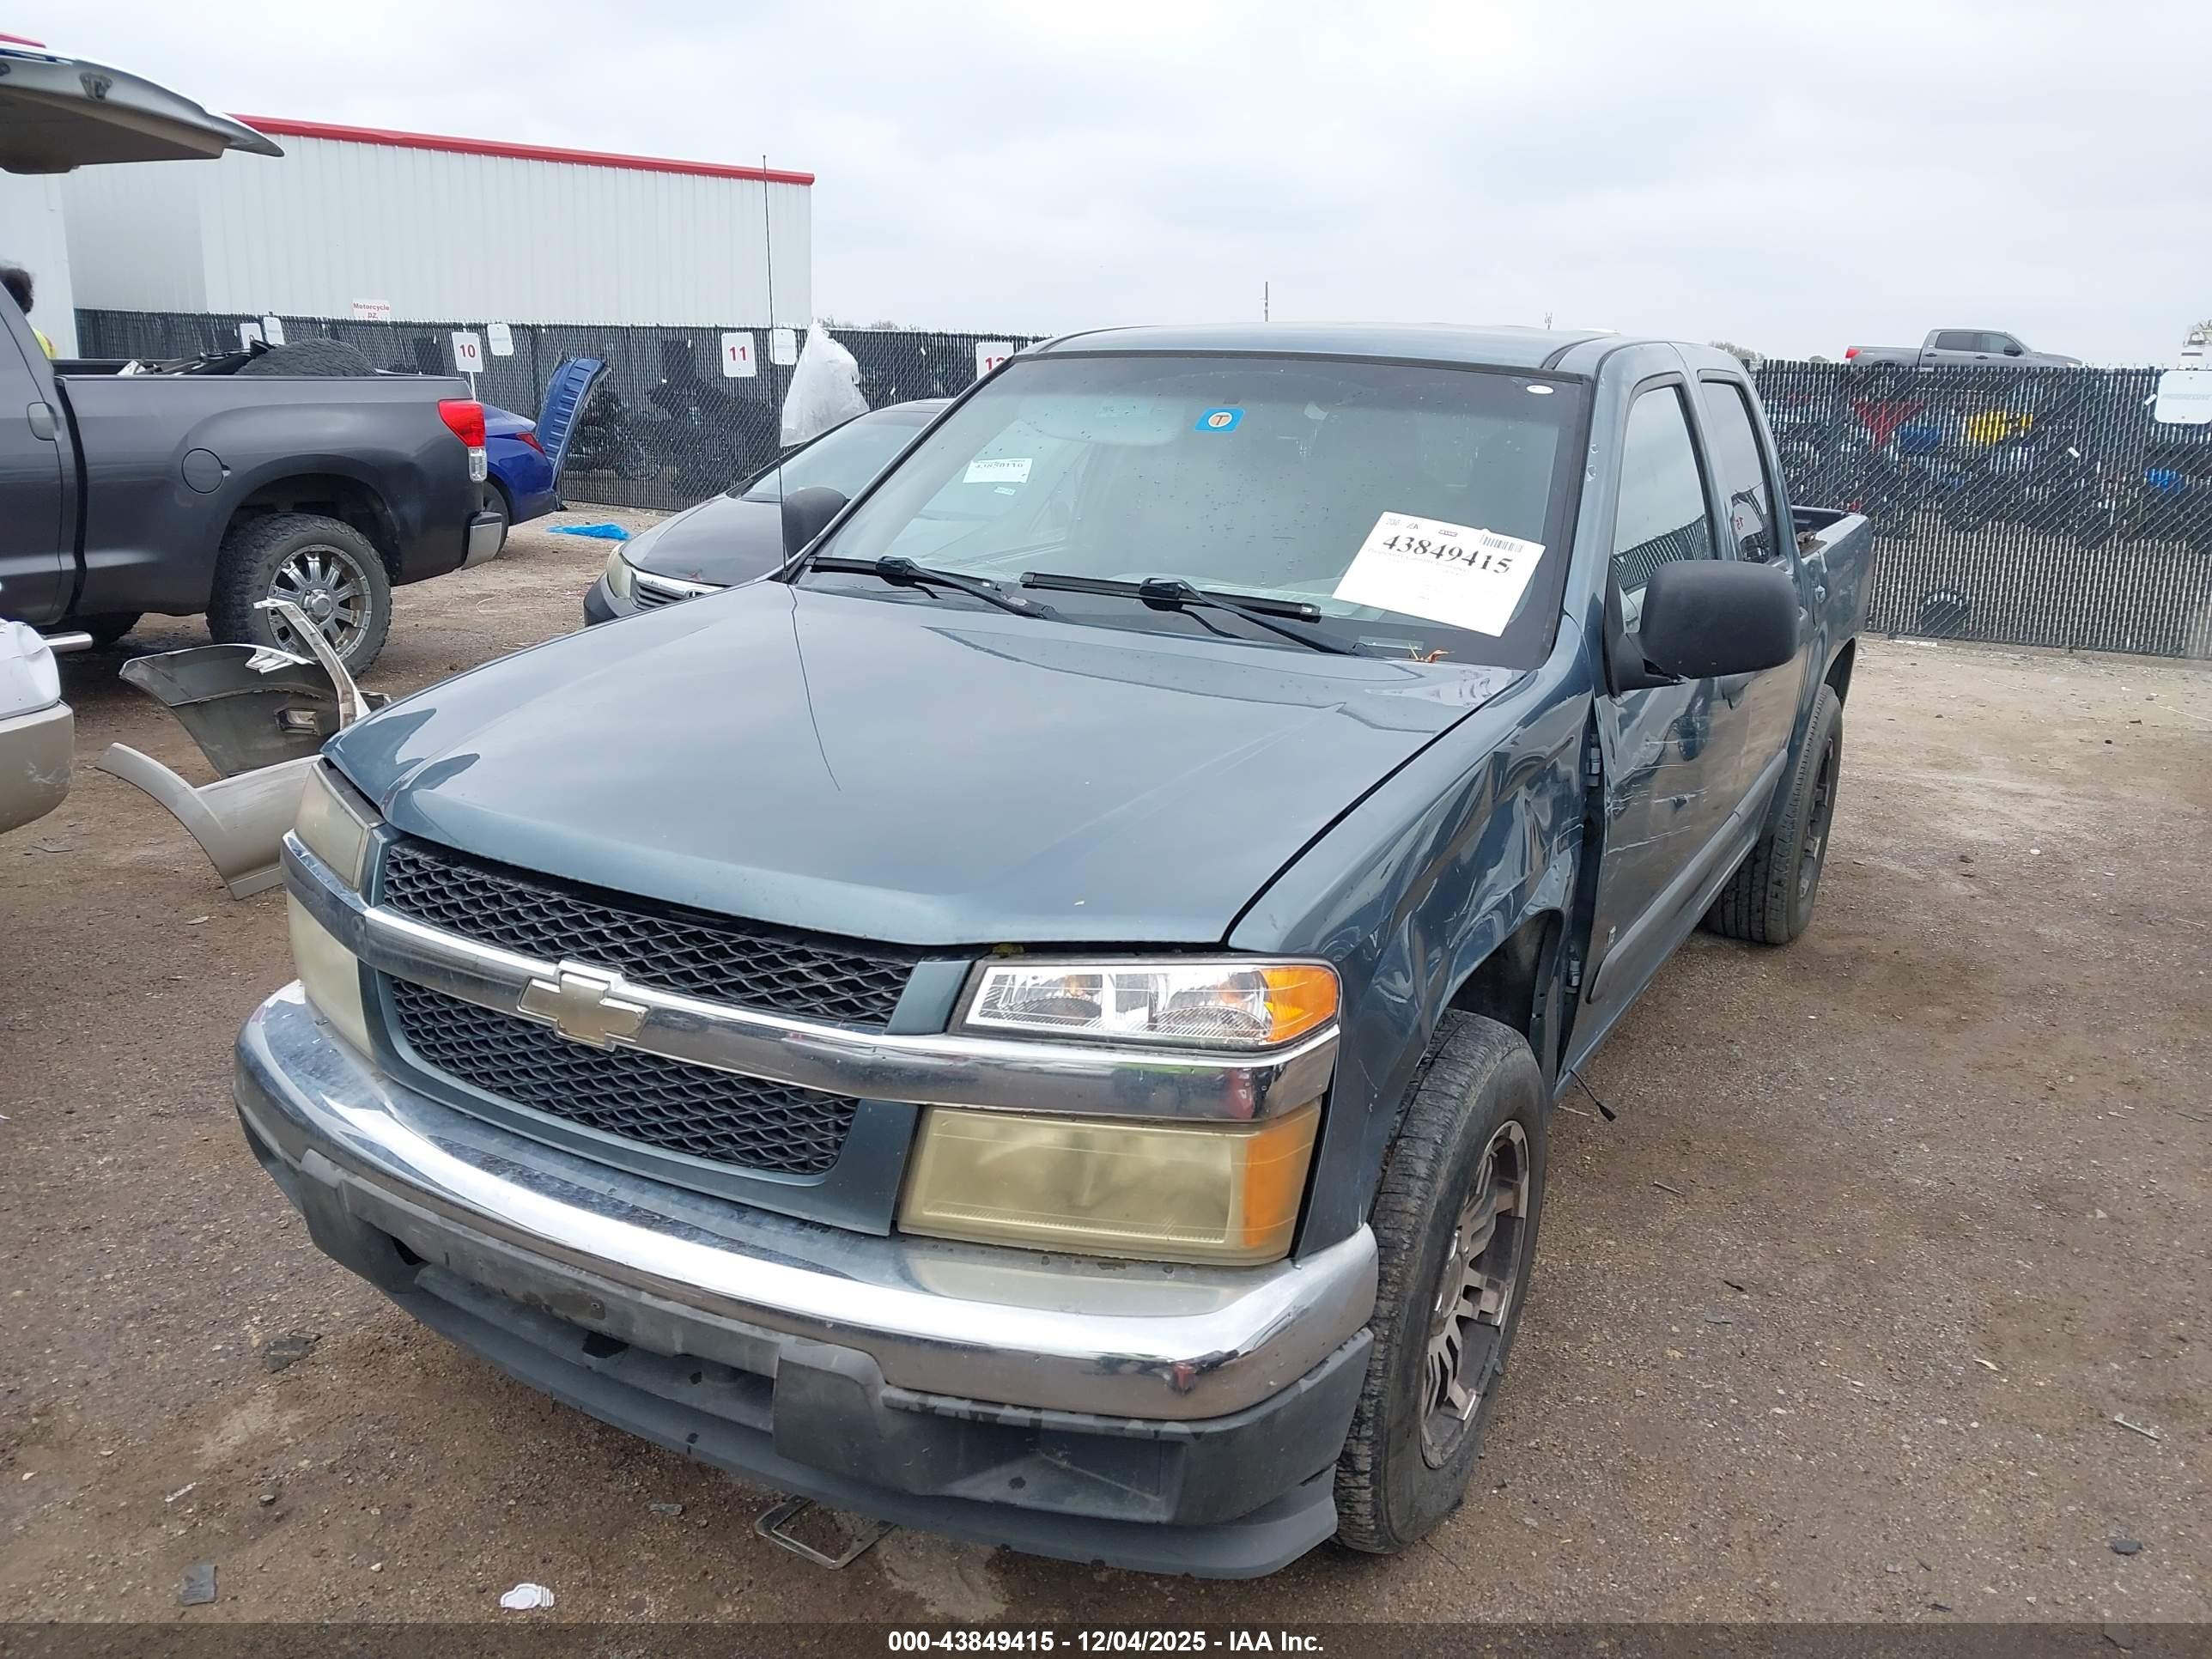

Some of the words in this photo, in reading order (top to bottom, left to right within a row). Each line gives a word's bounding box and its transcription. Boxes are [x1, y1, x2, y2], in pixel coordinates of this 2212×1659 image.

[353, 302, 390, 312] Motorcycle
[459, 343, 476, 359] 10
[729, 346, 747, 362] 11
[1215, 415, 1230, 426] T
[1382, 534, 1513, 574] 43849415
